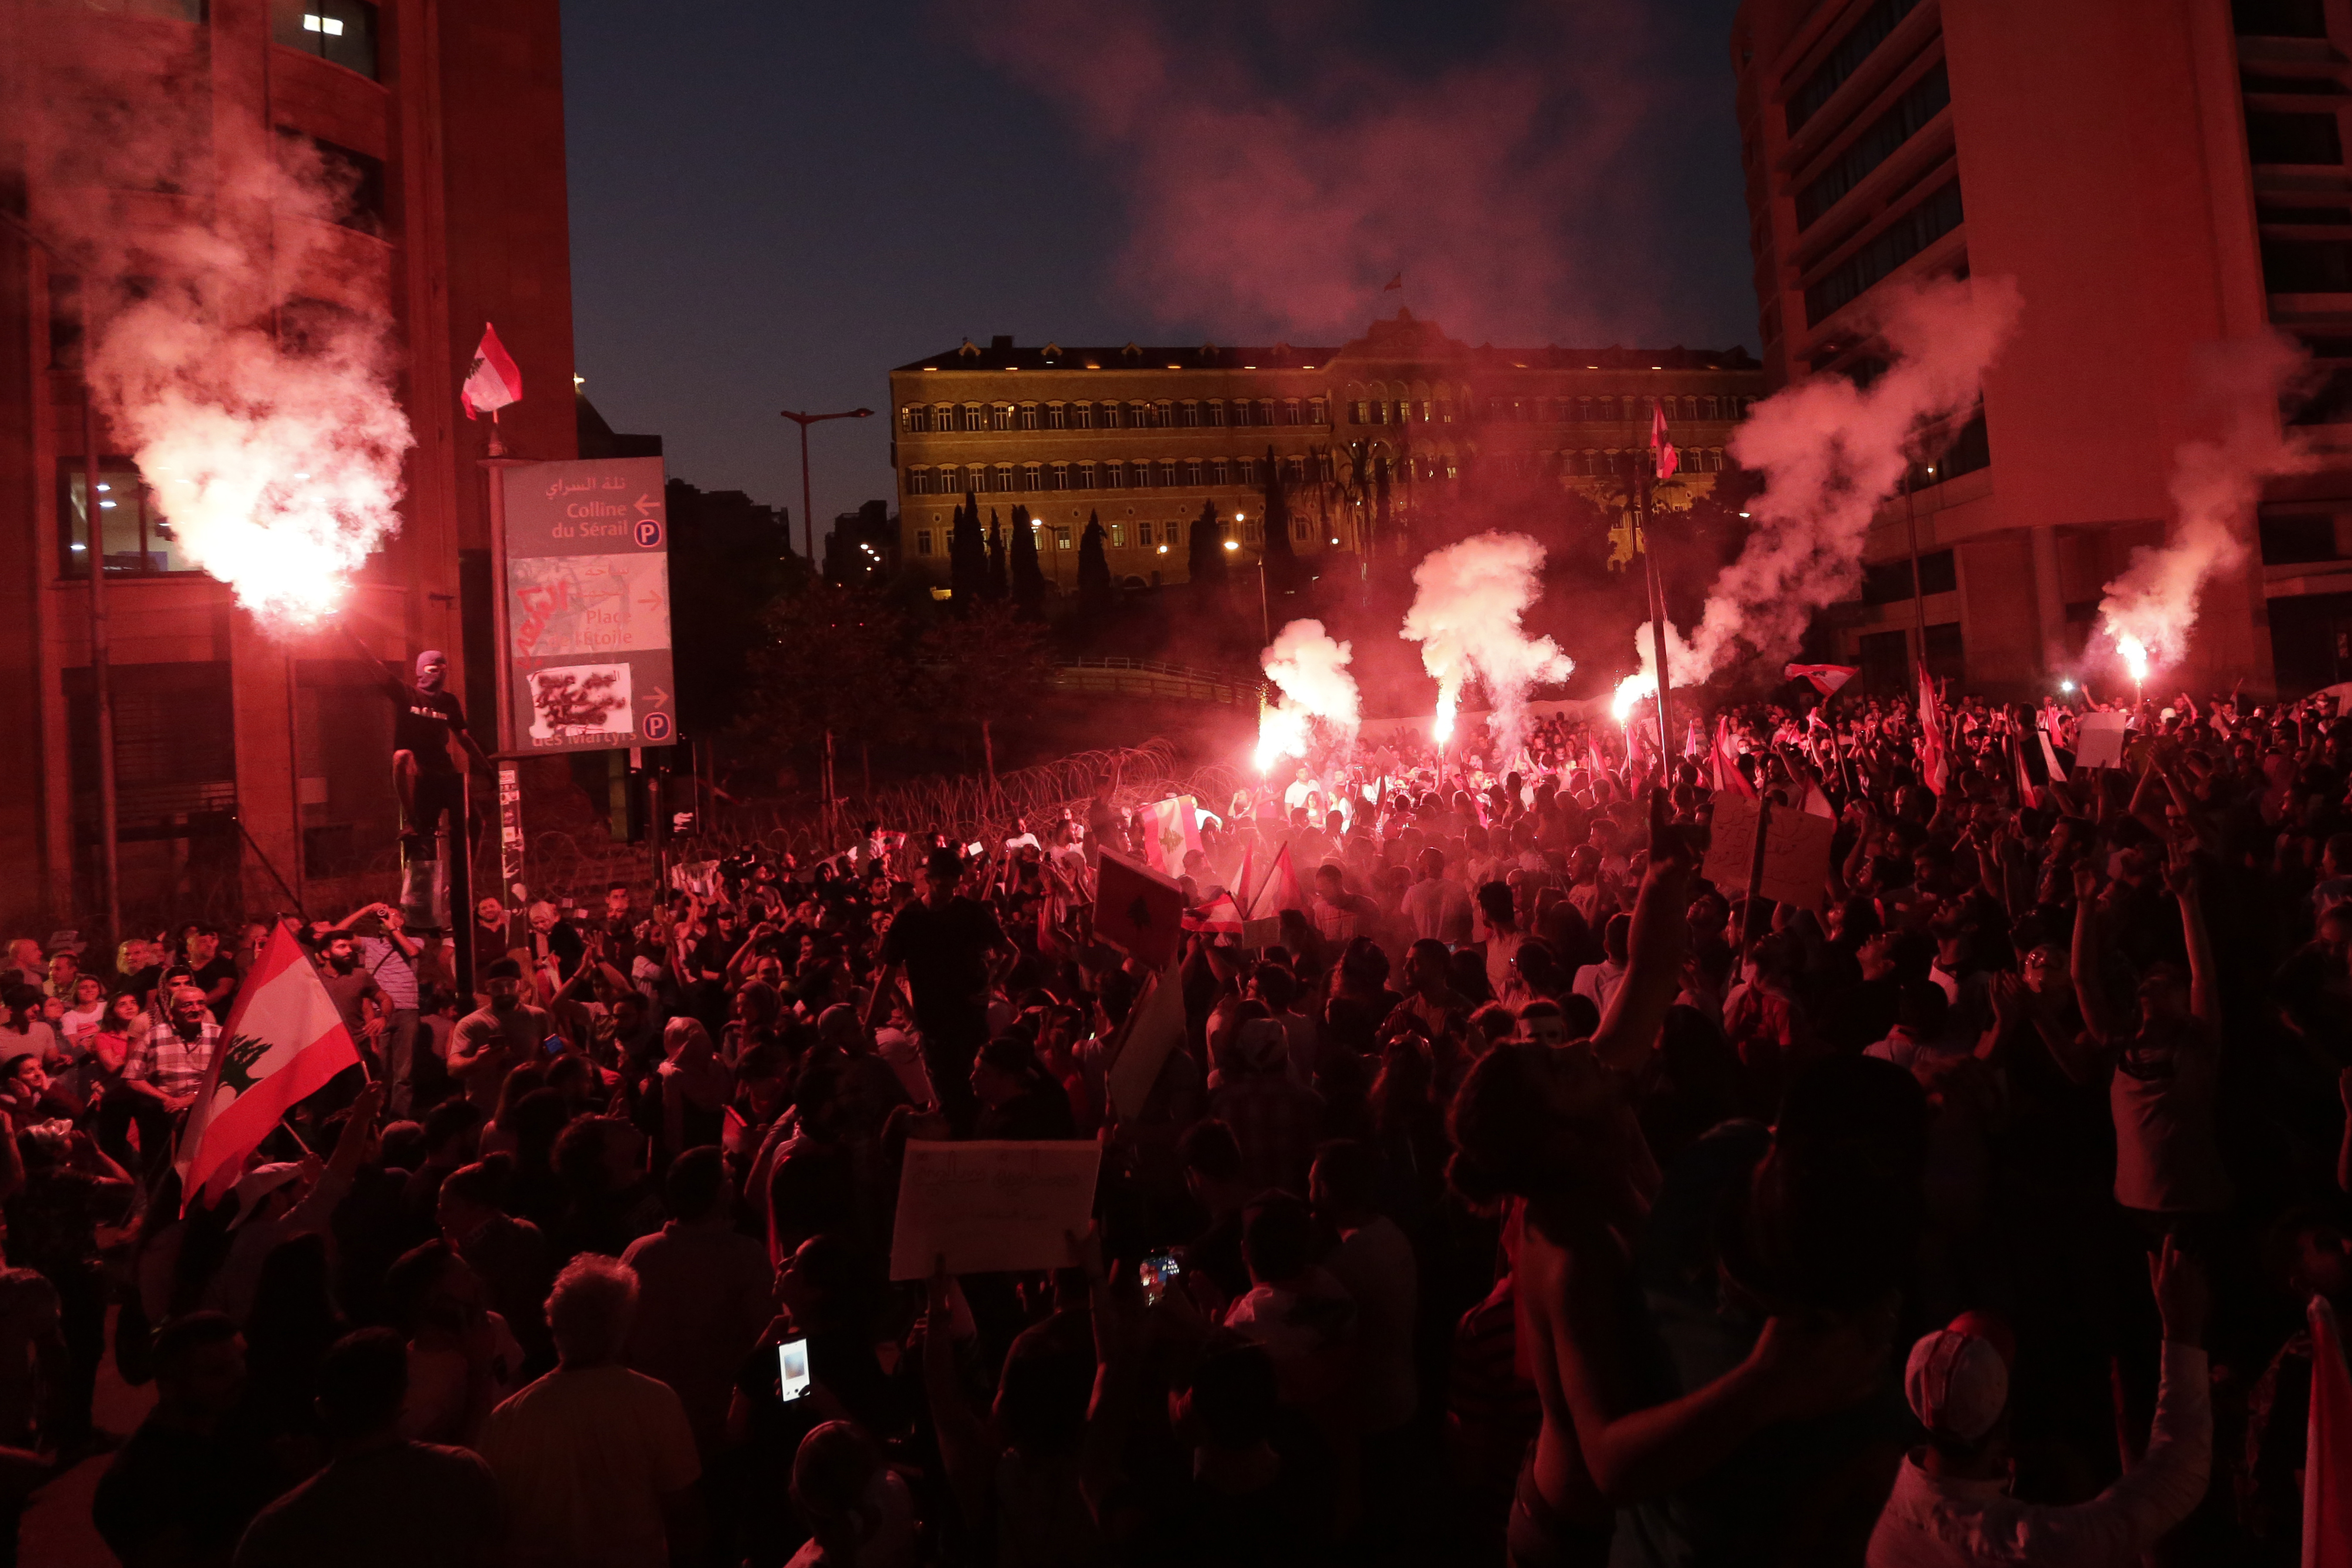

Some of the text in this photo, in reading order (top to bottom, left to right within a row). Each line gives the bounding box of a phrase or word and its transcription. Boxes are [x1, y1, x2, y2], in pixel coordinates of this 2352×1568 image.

[545, 477, 597, 500] السراي
[566, 501, 628, 518] Colline
[551, 520, 629, 538] du Sérail
[641, 524, 655, 543] P
[587, 608, 632, 625] Place
[649, 716, 664, 736] P
